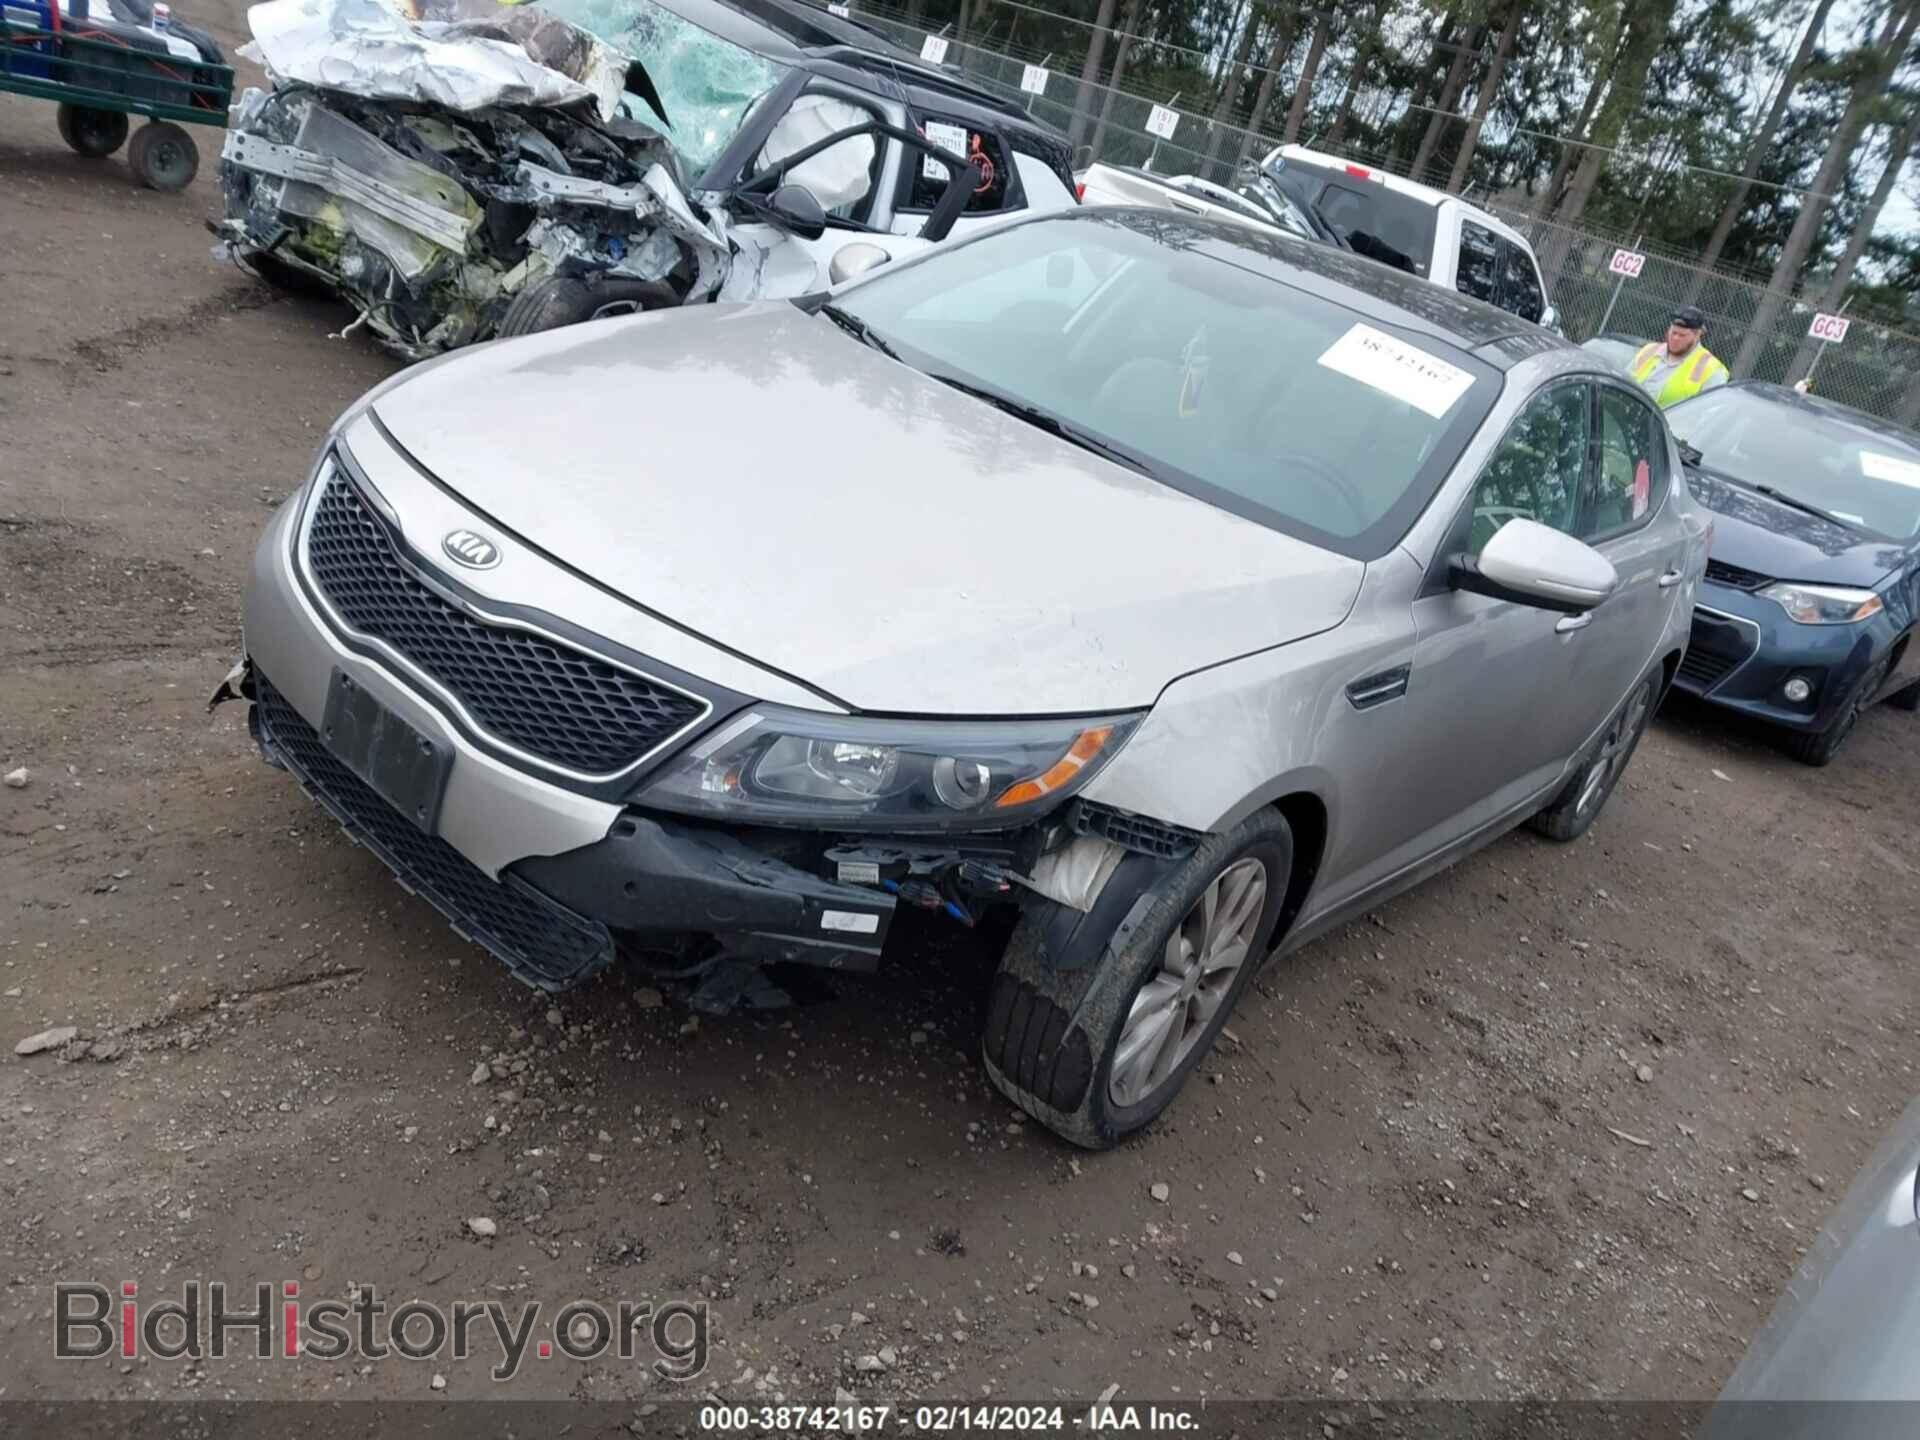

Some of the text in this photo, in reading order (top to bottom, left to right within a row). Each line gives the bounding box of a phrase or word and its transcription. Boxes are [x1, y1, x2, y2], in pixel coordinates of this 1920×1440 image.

[1613, 252, 1642, 274] GC2
[1813, 317, 1846, 338] GC3
[446, 530, 492, 564] KIA
